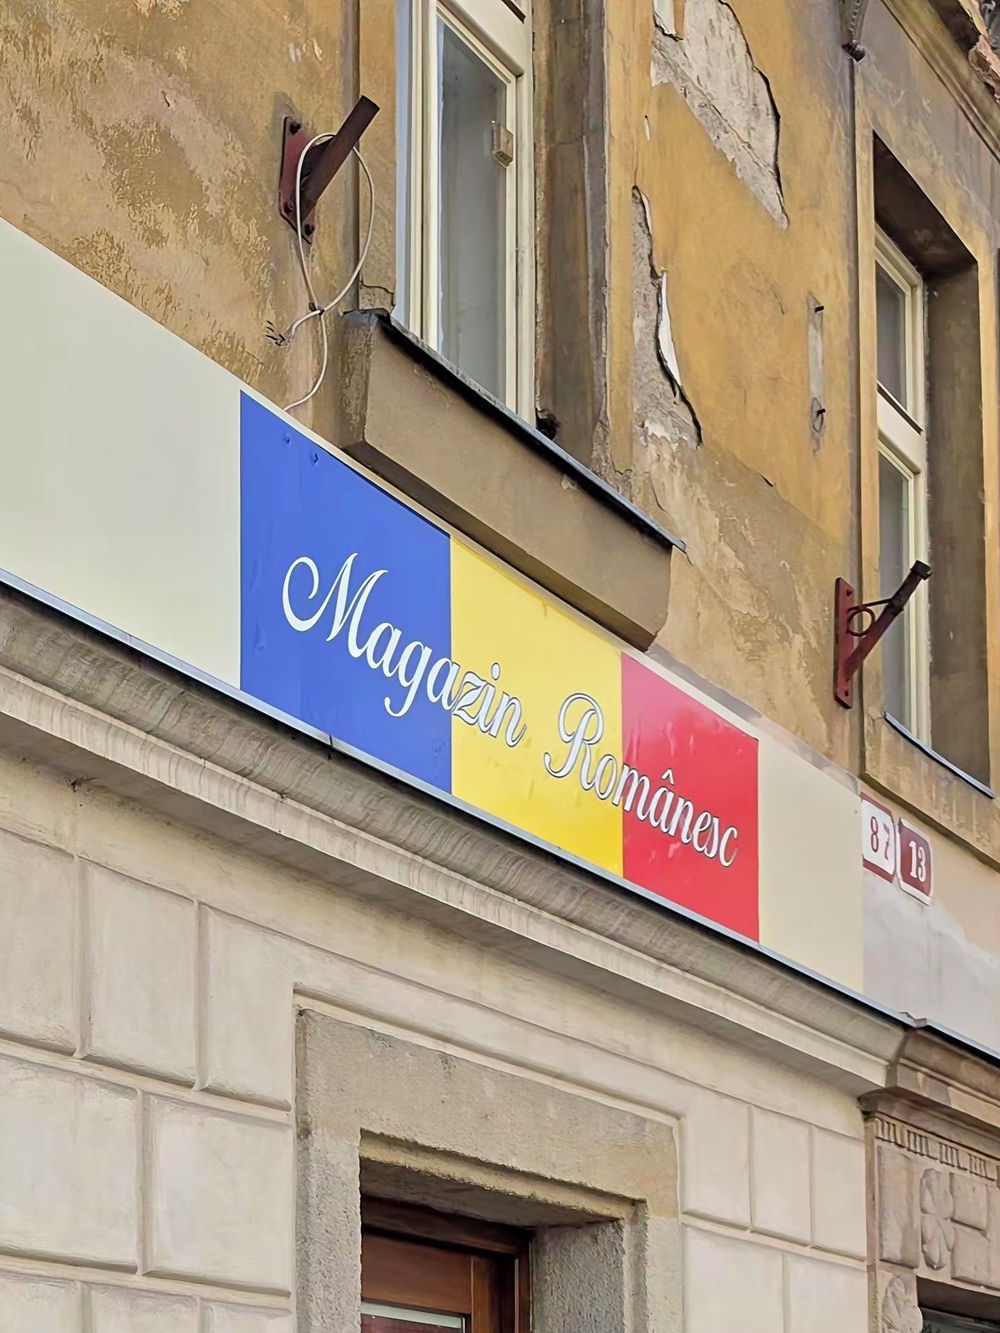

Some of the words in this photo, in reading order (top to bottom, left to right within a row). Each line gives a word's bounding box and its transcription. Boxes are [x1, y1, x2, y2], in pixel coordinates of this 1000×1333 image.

[281, 552, 528, 748] Magazin
[543, 692, 739, 868] Românesc
[909, 840, 927, 882] 13
